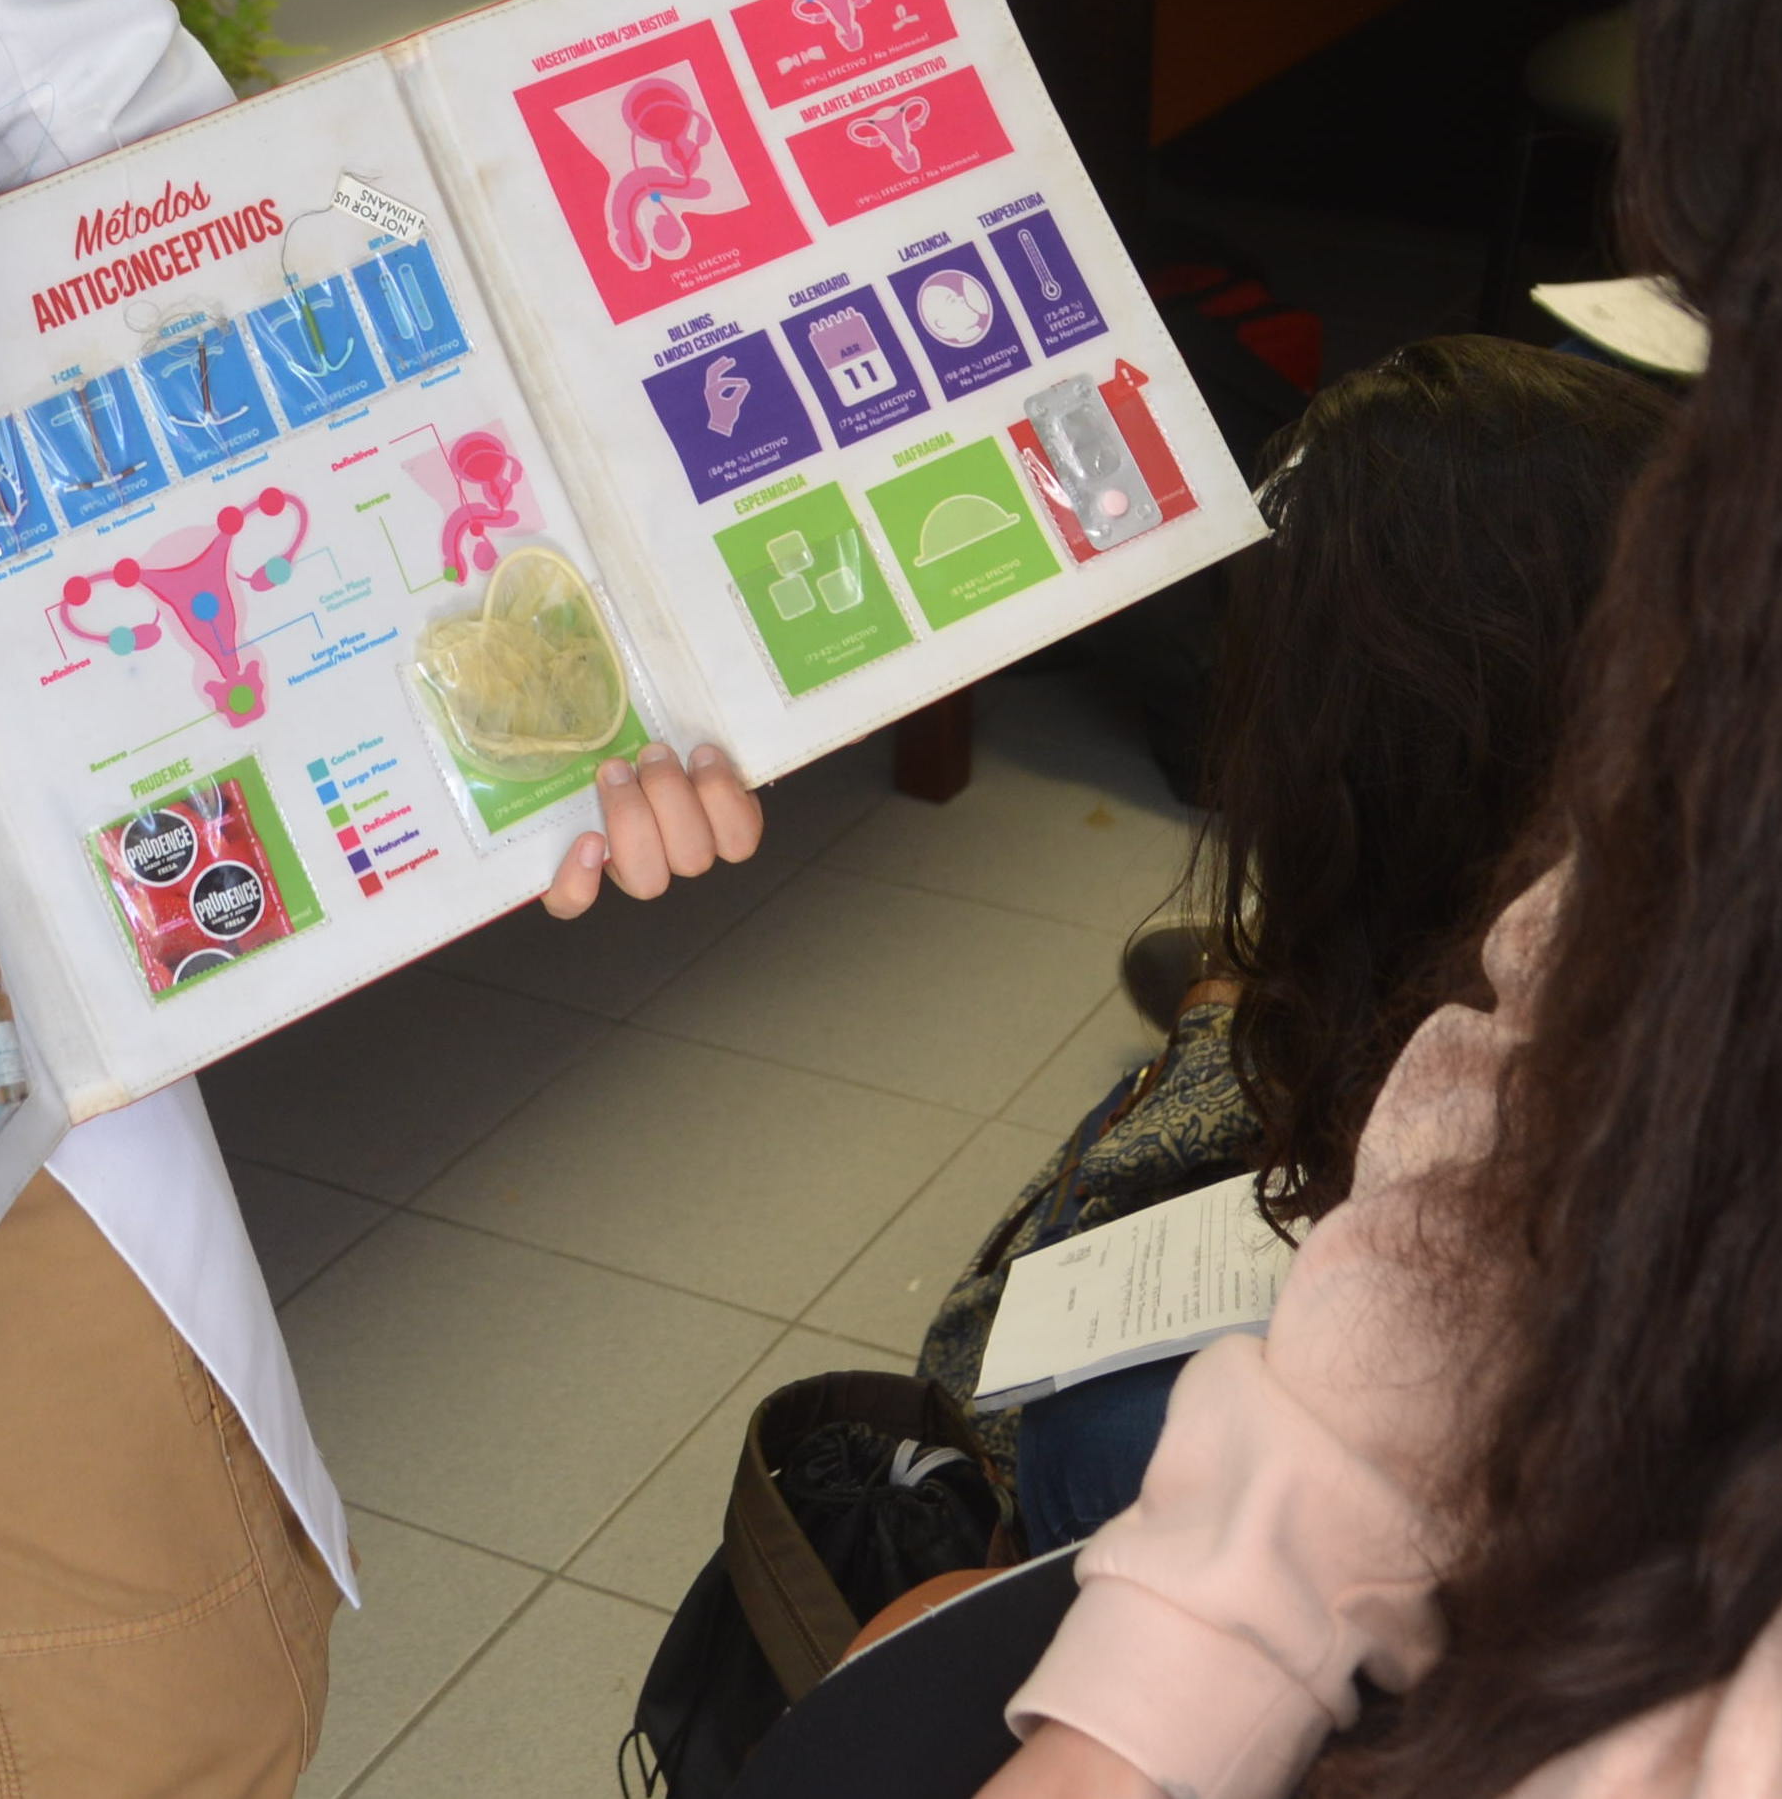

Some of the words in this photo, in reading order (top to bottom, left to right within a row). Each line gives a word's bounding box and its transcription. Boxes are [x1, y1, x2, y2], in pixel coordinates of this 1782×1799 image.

[532, 36, 597, 73] VASECTOMÍA
[596, 18, 640, 52] CON/SIN
[639, 5, 680, 35] BISTURÍ
[827, 57, 867, 80] EFECTIVO
[874, 48, 888, 60] No
[888, 32, 930, 55] Hormonal
[800, 96, 850, 123] IMPLANTE
[850, 76, 896, 106] MÉTALICO
[896, 55, 947, 88] DEFINITIVO
[881, 176, 919, 199] EFECTIVO
[926, 168, 939, 180] No
[939, 152, 981, 174] Hormonal
[75, 180, 210, 260] Métodos
[352, 200, 377, 222] FOR
[361, 189, 416, 224] HUMANS
[977, 191, 1045, 229] TEMPERATURA
[381, 215, 408, 236] NOT
[699, 248, 741, 271] EFECTIVO
[898, 231, 952, 263] LACTANCIA
[32, 199, 284, 333] ANTICONCEPTIVOS
[679, 277, 695, 291] No
[694, 259, 742, 285] Hormonal
[788, 272, 851, 308] CALENDARIO
[667, 313, 714, 342] BILLINGS
[1045, 334, 1059, 346] No
[1059, 317, 1099, 340] Hormonal
[1049, 311, 1086, 333] EFECTIVO
[654, 354, 664, 368] O
[664, 340, 697, 364] MOCO
[695, 321, 744, 352] CERVICAL
[840, 343, 861, 358] ABR
[983, 344, 1019, 366] EFECTIVO
[420, 366, 461, 388] Hormonal
[844, 361, 878, 390] 11
[959, 376, 972, 388] No
[972, 359, 1013, 383] Hormonal
[879, 389, 917, 412] EFECTIVO
[328, 407, 369, 431] Hormonal
[855, 421, 869, 434] No
[868, 405, 909, 427] Hormonal
[331, 446, 379, 472] Definitivos
[750, 436, 789, 460] EFECTIVO
[892, 431, 956, 469] DIAFRAGMA
[212, 471, 225, 484] No
[226, 453, 269, 476] Hormonal
[723, 469, 738, 482] No
[739, 451, 781, 476] Hormonal
[733, 473, 808, 515] ESPERMICIDA
[97, 522, 111, 535] No
[112, 503, 155, 529] Hormonal
[9, 549, 54, 575] Hormonal
[984, 559, 1021, 582] EFECTIVO
[964, 588, 977, 602] No
[312, 643, 338, 662] Largo
[340, 631, 367, 648] Plazo
[353, 627, 399, 656] hormonal
[841, 625, 878, 648] EFECTIVO
[40, 656, 92, 687] Definitivos
[90, 750, 127, 773] Barrera
[331, 750, 356, 765] Corto
[358, 737, 384, 753] Plazo
[130, 757, 194, 799] PRUDENCE
[343, 771, 369, 789] Largo
[371, 758, 397, 775] Plazo
[363, 805, 412, 833] Definitivos
[126, 825, 193, 869] PRUDENCE
[373, 830, 420, 856] Naturales
[157, 863, 178, 876] FRESA
[385, 848, 439, 879] Emergencia
[195, 879, 260, 923] PRUDENCE
[224, 916, 246, 930] FRESA
